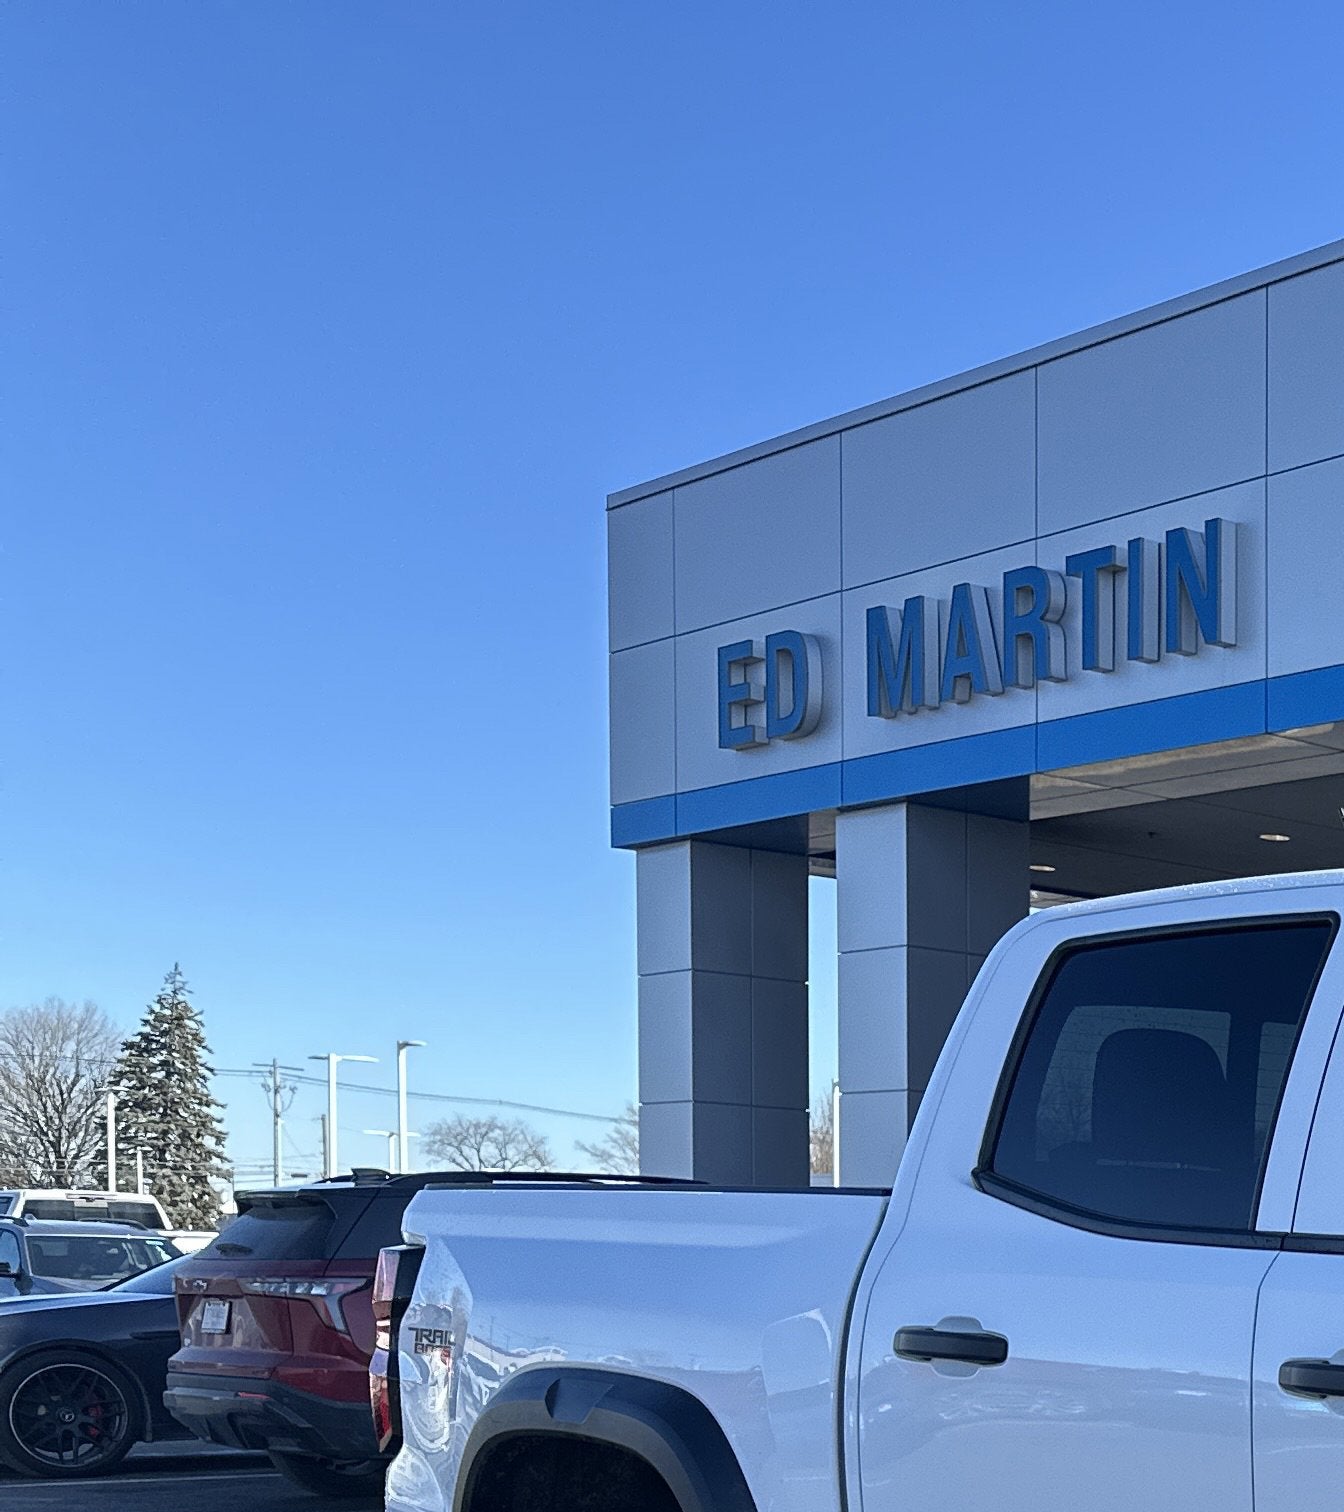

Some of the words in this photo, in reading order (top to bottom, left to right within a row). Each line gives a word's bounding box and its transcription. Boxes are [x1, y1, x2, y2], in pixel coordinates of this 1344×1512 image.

[718, 630, 822, 750] ED
[866, 518, 1237, 719] MARTIN
[408, 1326, 457, 1347] TRAIL
